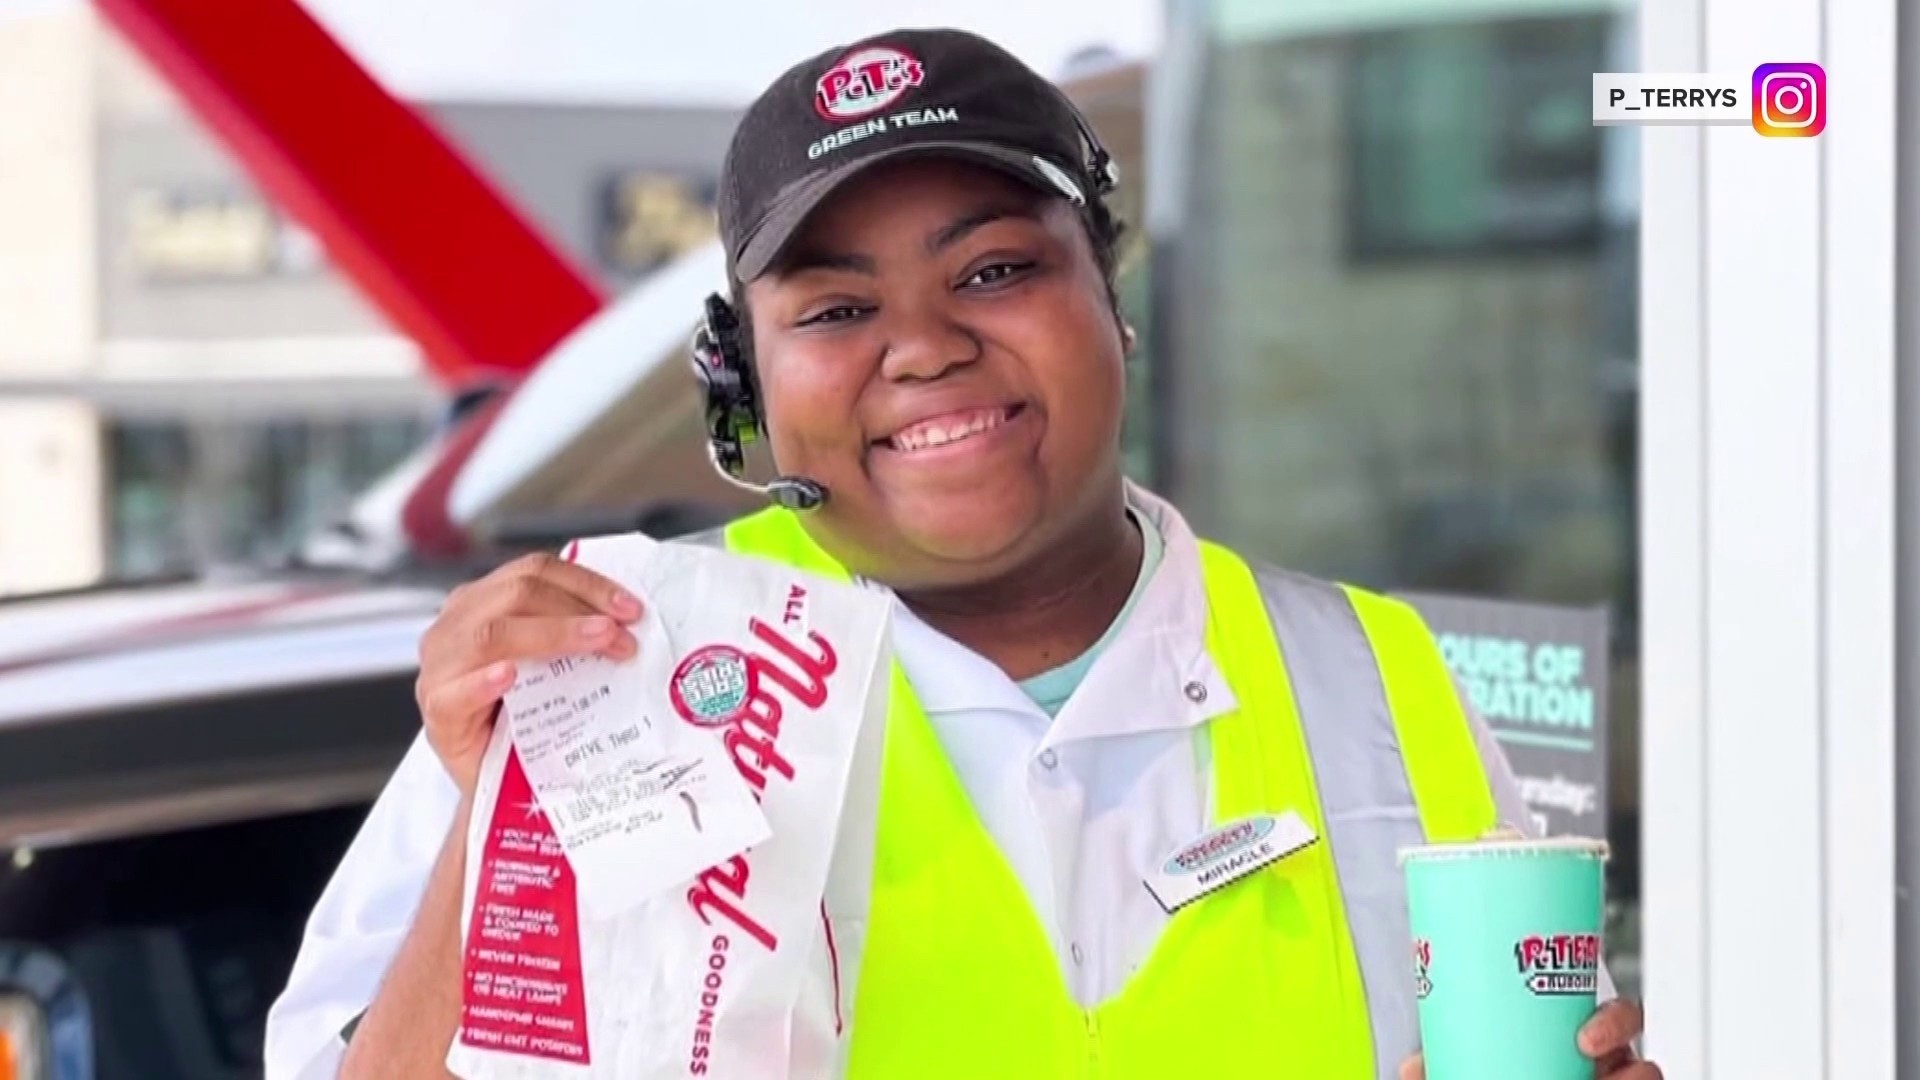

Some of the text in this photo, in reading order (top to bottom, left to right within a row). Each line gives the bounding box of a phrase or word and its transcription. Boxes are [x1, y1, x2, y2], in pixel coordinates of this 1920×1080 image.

[808, 107, 959, 160] GREEN TEAM
[782, 583, 808, 625] ALL
[1438, 633, 1584, 685] OURS OF
[1465, 680, 1594, 730] RATION
[564, 736, 607, 767] DRIVE
[609, 726, 641, 751] THRU
[1196, 841, 1274, 886] MIRACLE
[544, 923, 560, 937] TO
[478, 951, 516, 965] NEVER
[690, 934, 729, 1077] GOODNESS
